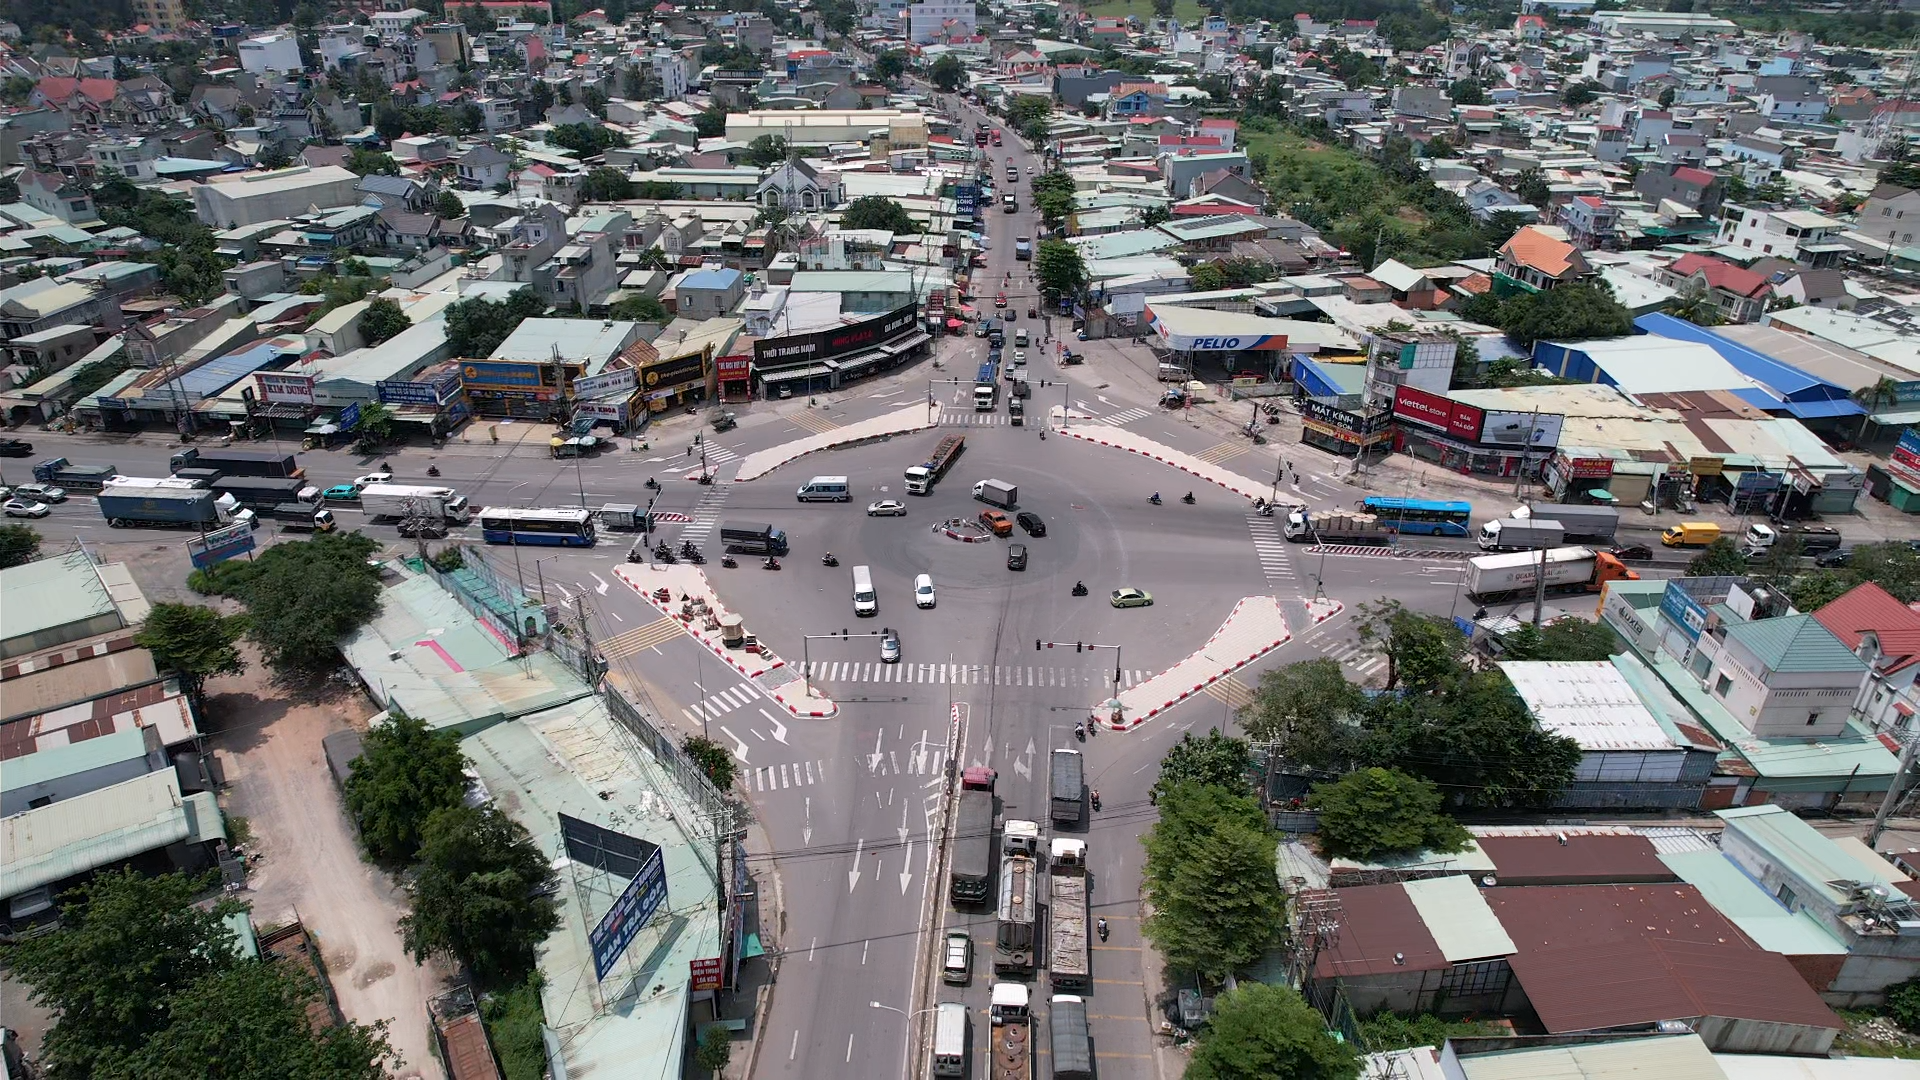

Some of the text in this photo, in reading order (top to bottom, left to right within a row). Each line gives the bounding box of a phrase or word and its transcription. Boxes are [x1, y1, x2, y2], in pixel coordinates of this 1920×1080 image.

[1193, 337, 1240, 349] PELIO
[763, 343, 816, 359] THỜI TRANG NAM
[267, 384, 285, 394] KIM
[1399, 398, 1447, 418] viettel store
[1332, 411, 1354, 425] KÍNH
[600, 880, 662, 966] BÁN TRẢ GÓP
